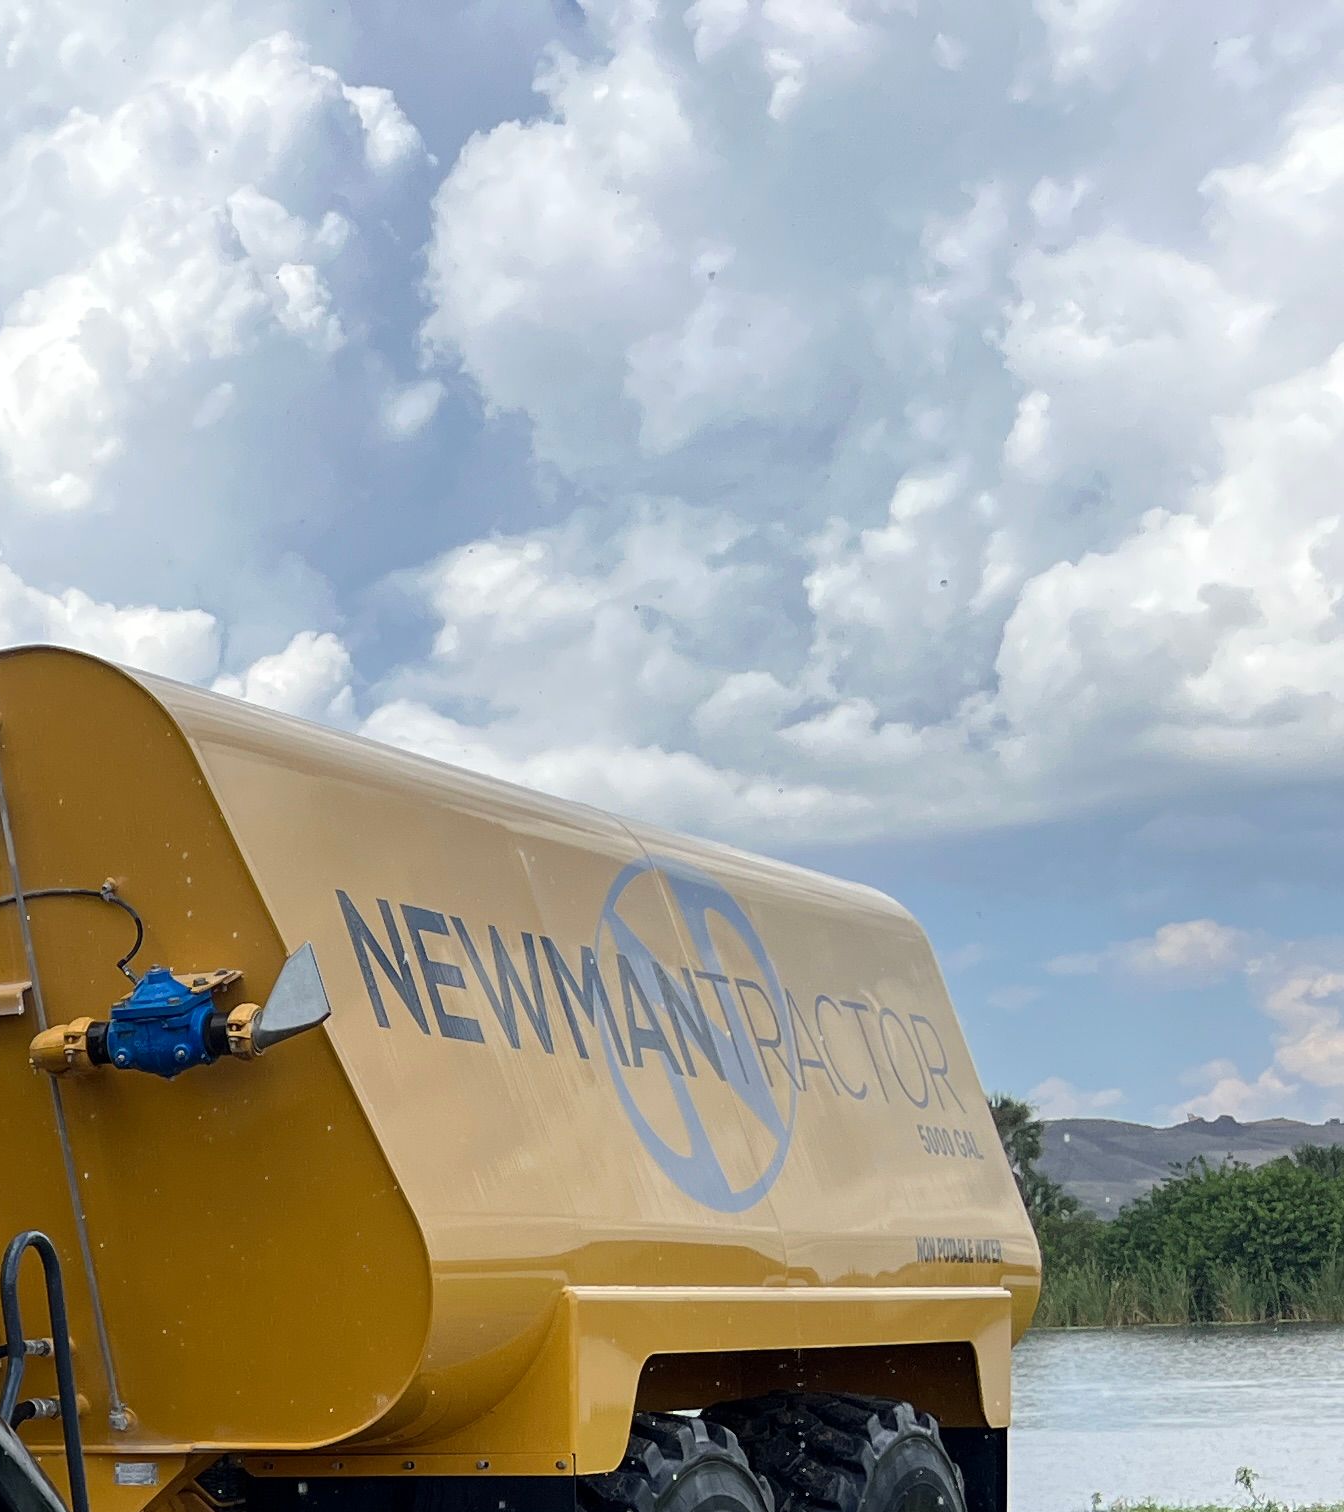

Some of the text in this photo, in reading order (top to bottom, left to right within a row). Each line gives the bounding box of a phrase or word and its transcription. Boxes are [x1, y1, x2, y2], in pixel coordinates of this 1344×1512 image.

[916, 1124, 955, 1157] 5000
[916, 1236, 1003, 1264] NON POTABLE WATER
